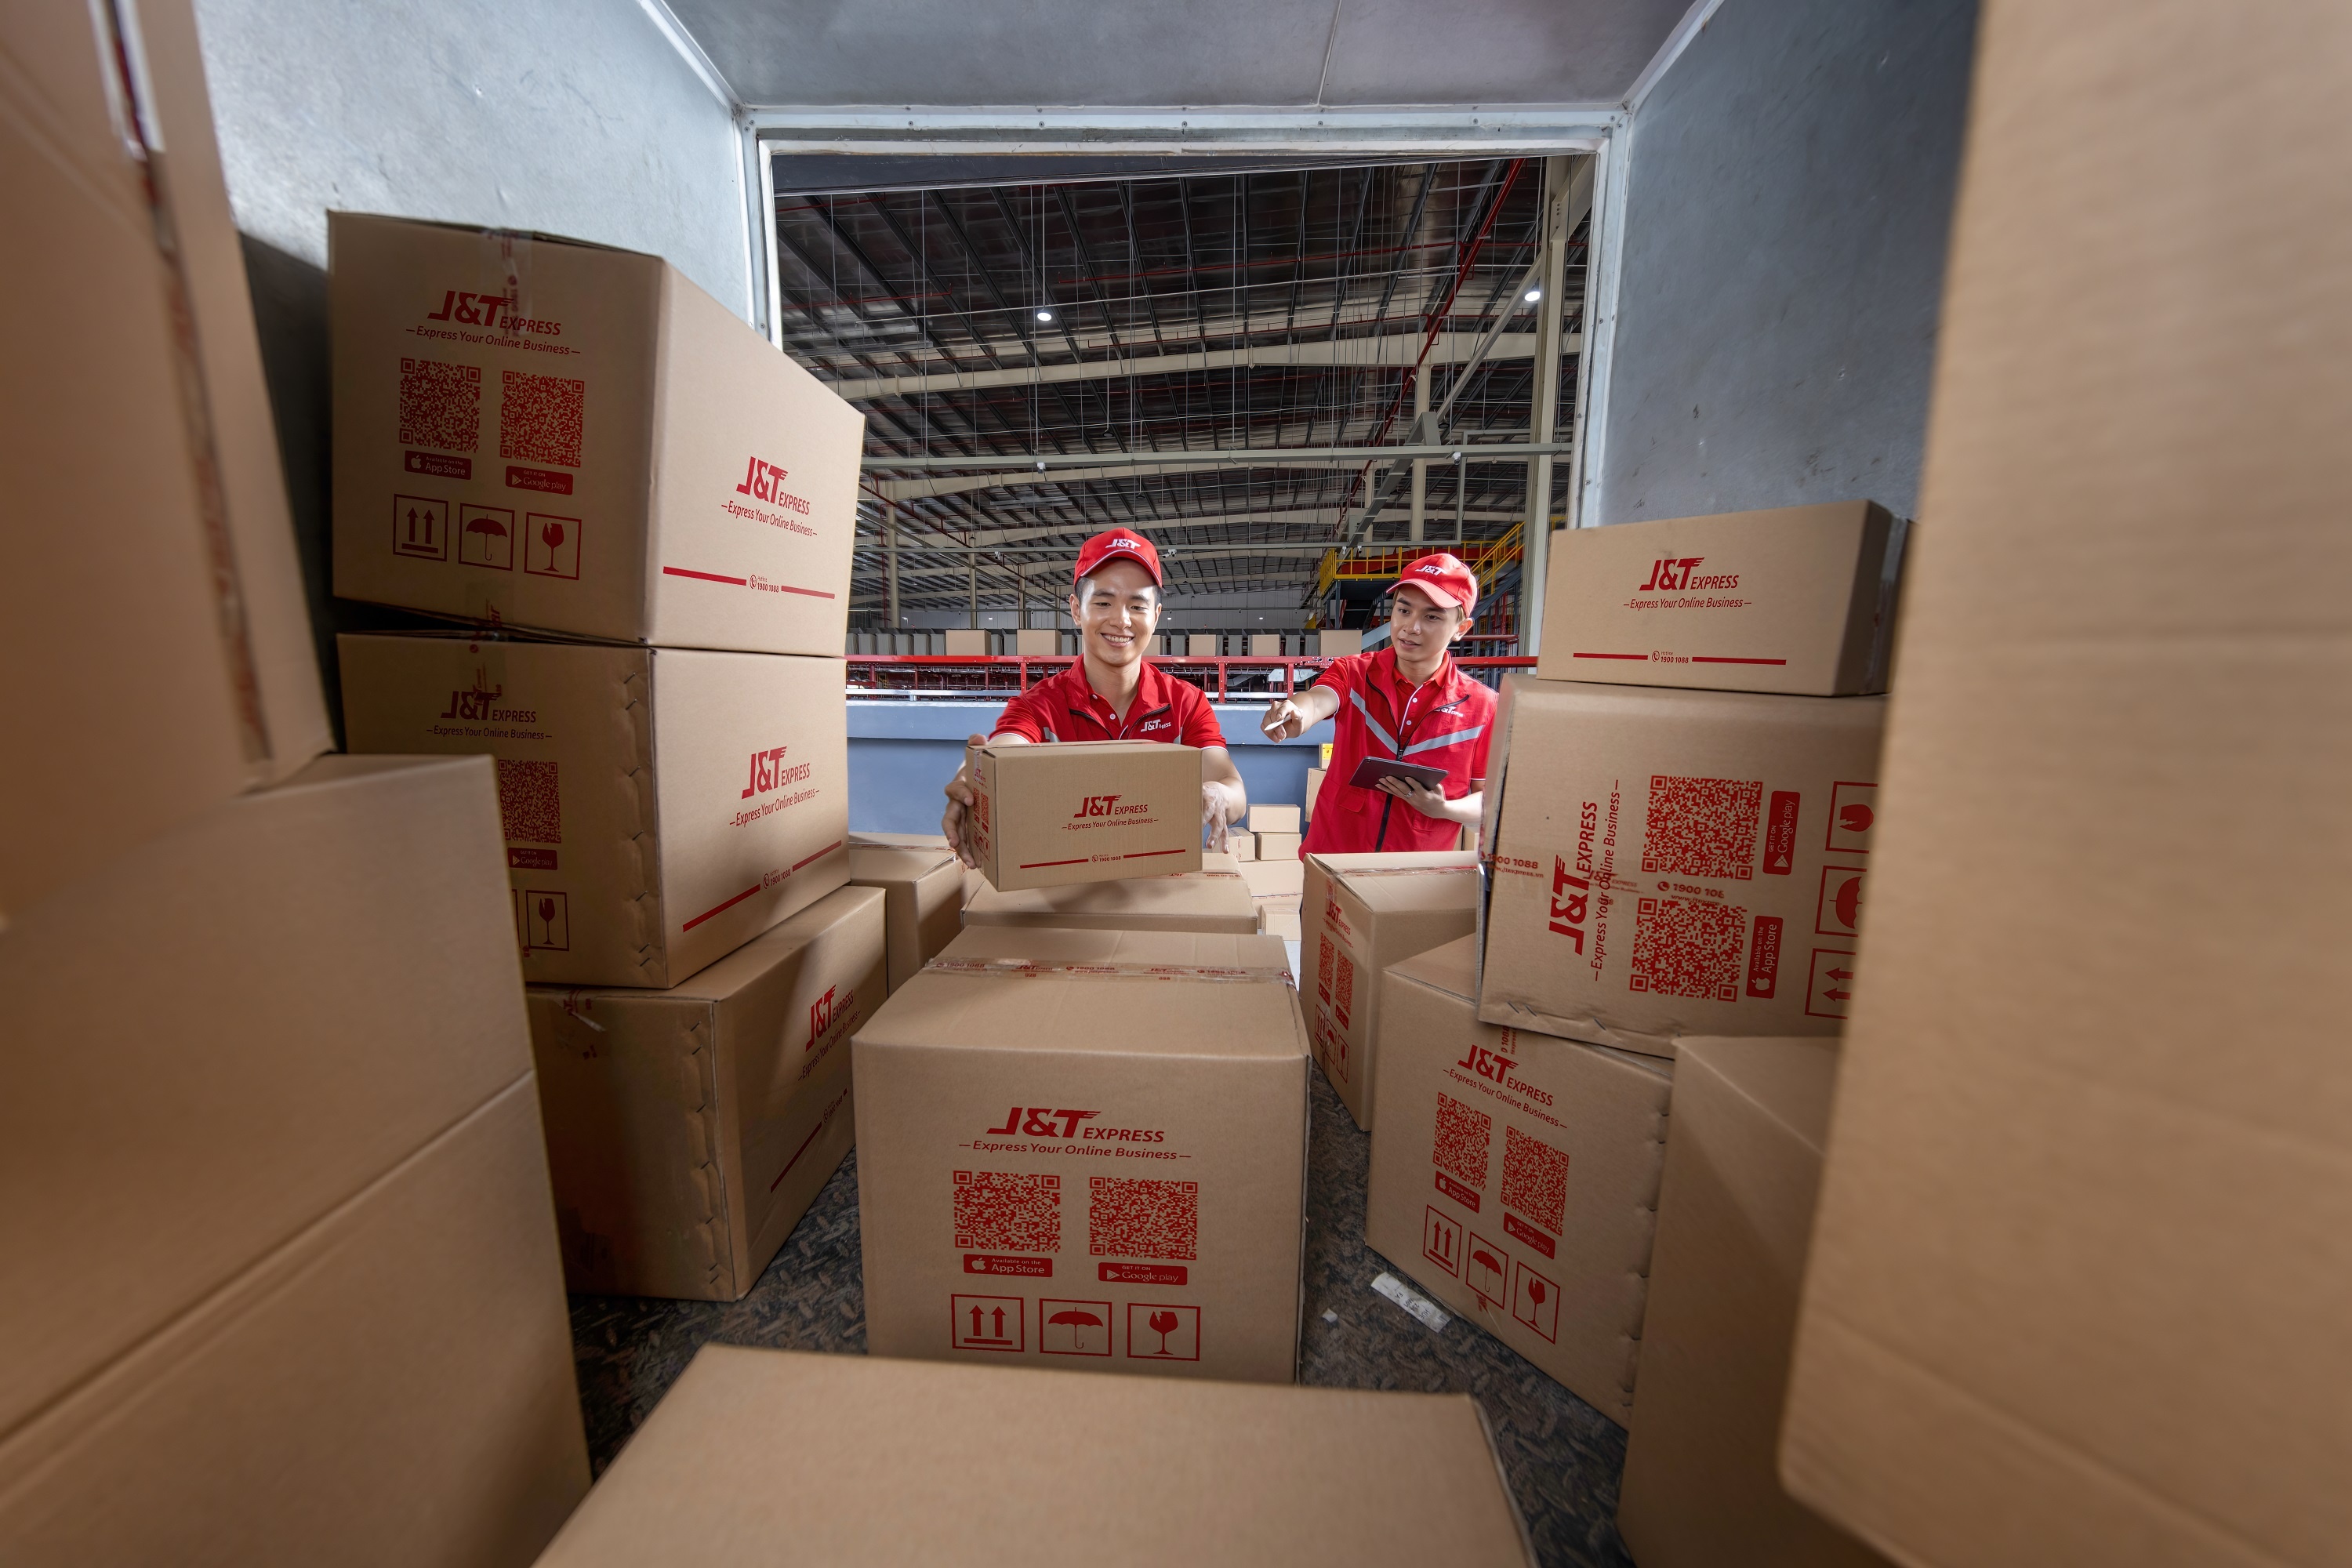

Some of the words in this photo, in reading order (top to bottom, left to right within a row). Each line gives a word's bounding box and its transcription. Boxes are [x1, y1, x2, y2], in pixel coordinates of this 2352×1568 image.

[427, 290, 514, 327] J&T
[499, 316, 561, 336] EXPRESS
[416, 325, 457, 339] Express
[459, 331, 484, 343] Your
[485, 335, 521, 348] Online
[523, 339, 570, 354] Business
[426, 463, 443, 474] App
[444, 464, 466, 476] Store
[523, 477, 550, 489] Google
[551, 480, 567, 491] play
[736, 456, 788, 504] J&T
[779, 492, 810, 515] EXPRESS
[728, 500, 754, 519] Express
[755, 509, 769, 523] Your
[770, 514, 789, 529] Online
[789, 520, 812, 536] Business
[1105, 539, 1141, 549] J&T
[1415, 564, 1448, 575] J&T
[1639, 557, 1705, 591] J&T
[1690, 575, 1740, 590] EXPRESS
[1630, 598, 1659, 611] Express
[1660, 598, 1678, 608] Your
[1678, 597, 1705, 608] Online
[1706, 597, 1744, 608] Business
[441, 691, 502, 720] J&T
[492, 709, 536, 723] EXPRESS
[434, 725, 463, 737] Express
[464, 726, 481, 737] Your
[483, 728, 509, 739] Online
[510, 728, 544, 739] Business
[1141, 719, 1161, 732] J&T
[742, 746, 787, 800] J&T
[782, 762, 810, 786] EXPRESS
[736, 808, 760, 828] Express
[761, 803, 775, 816] Your
[775, 795, 793, 811] Online
[794, 788, 815, 804] Business
[1073, 795, 1122, 818] J&T
[1114, 804, 1148, 815] EXPRESS
[1603, 792, 1620, 847] Business
[1783, 800, 1795, 818] play
[1777, 819, 1794, 852] Google
[521, 856, 540, 867] Google
[1513, 858, 1538, 869] 1088
[1599, 849, 1613, 890] Online
[1549, 855, 1589, 956] J&T
[1577, 801, 1597, 873] EXPRESS
[1673, 884, 1701, 895] 1900
[1595, 892, 1610, 919] Your
[1591, 922, 1606, 970] Express
[1764, 924, 1777, 951] Store
[1762, 953, 1776, 973] App
[806, 984, 836, 1052] J&T
[833, 989, 854, 1023] EXPRESS
[802, 1054, 819, 1079] Express
[819, 1043, 829, 1059] Your
[829, 1029, 842, 1048] Online
[842, 1011, 858, 1034] Business
[1457, 1044, 1519, 1084] J&T
[1507, 1077, 1554, 1107] EXPRESS
[1450, 1069, 1477, 1087] Express
[1479, 1082, 1495, 1096] Your
[1496, 1091, 1522, 1109] Online
[1523, 1103, 1559, 1127] Business
[986, 1107, 1102, 1138] J&T
[1083, 1127, 1164, 1143] EXPRESS
[973, 1141, 1027, 1153] Express
[1030, 1143, 1062, 1154] Your
[1065, 1145, 1112, 1156] Online
[1115, 1148, 1178, 1160] Business
[1448, 1187, 1460, 1199] App
[1461, 1193, 1475, 1207] Store
[1516, 1228, 1537, 1245] Google
[1537, 1242, 1549, 1253] play
[991, 1264, 1014, 1273] App
[1016, 1265, 1045, 1274] Store
[1122, 1271, 1157, 1282] Google
[1159, 1273, 1179, 1283] play
